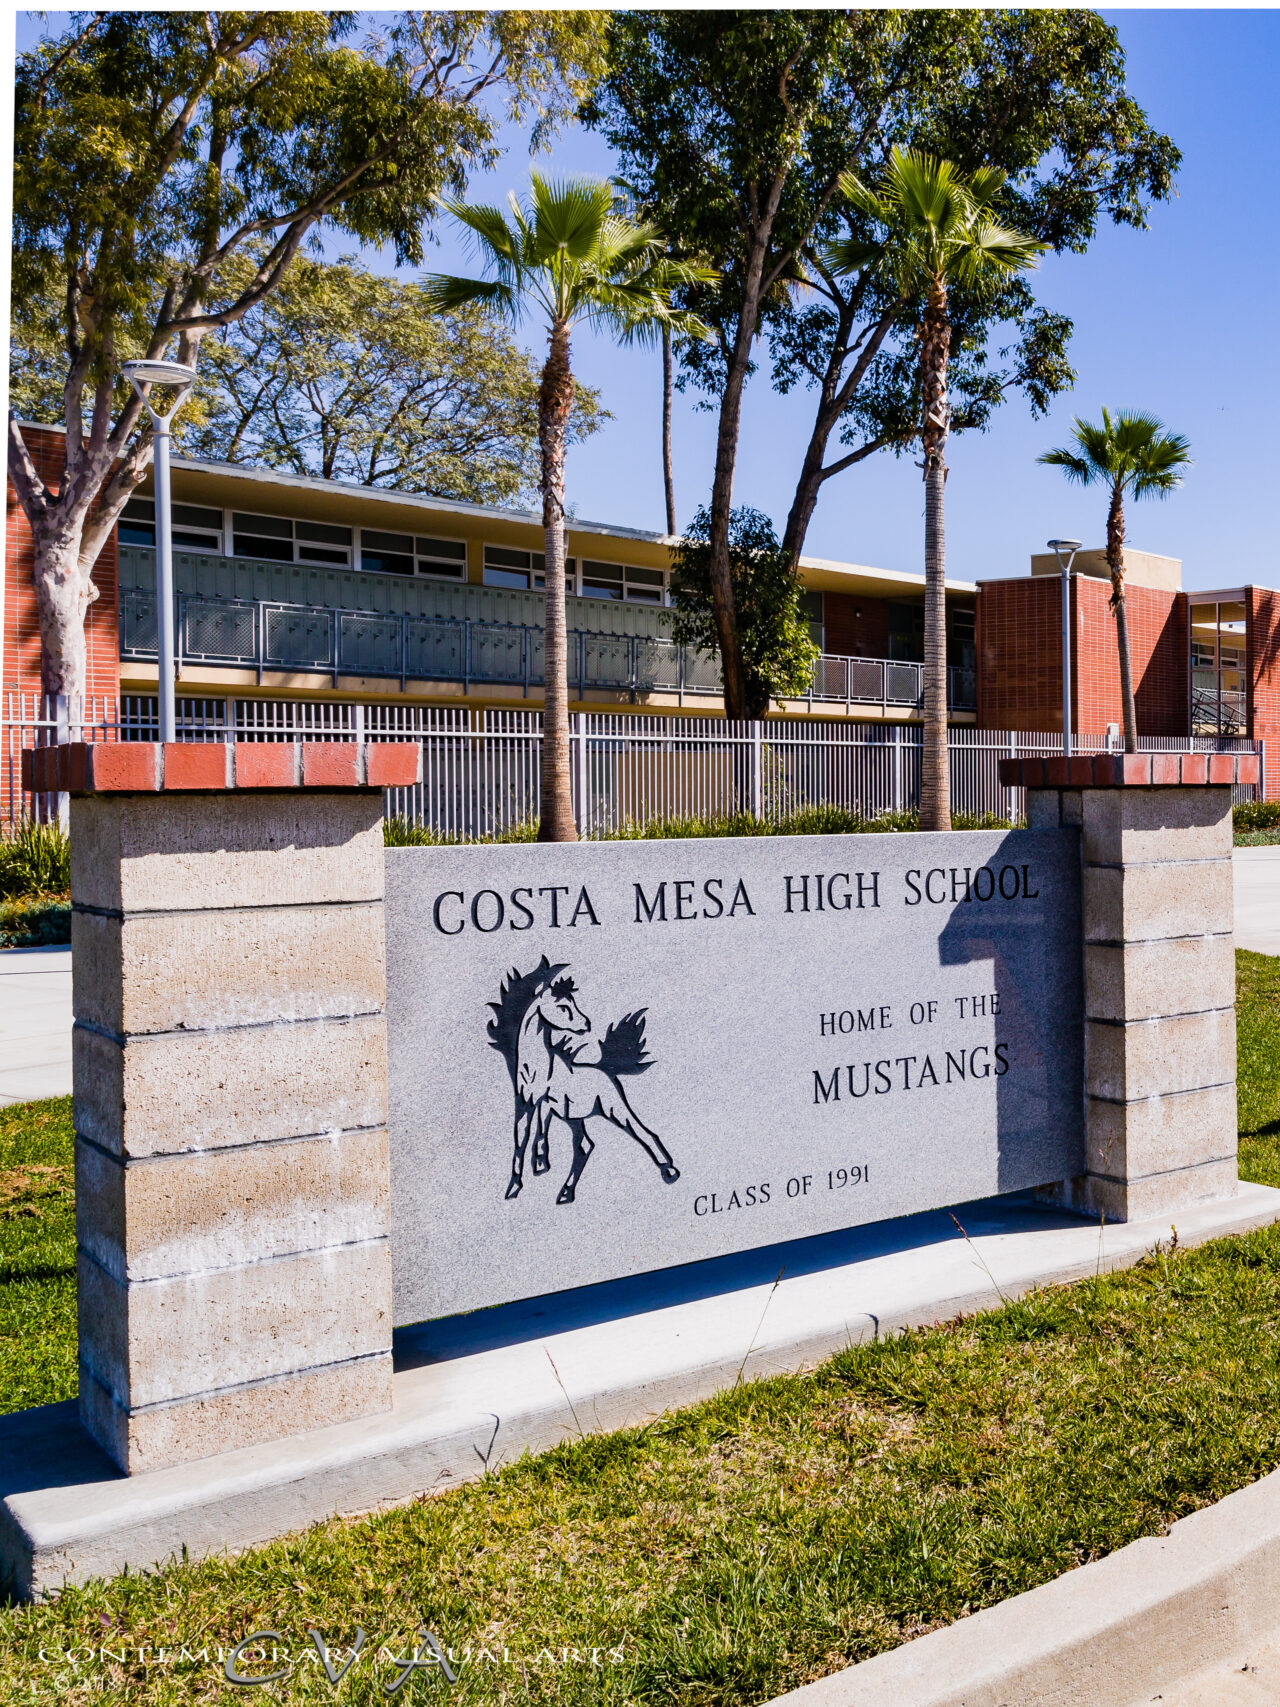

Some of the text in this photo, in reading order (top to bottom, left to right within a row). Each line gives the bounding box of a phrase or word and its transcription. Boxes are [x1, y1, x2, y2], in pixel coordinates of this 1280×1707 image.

[432, 864, 1039, 935] COSTA MESA HIGH SCHOOL
[819, 993, 1001, 1036] HOME OF THE
[812, 1043, 1009, 1104] MUSTANGS
[693, 1164, 870, 1217] CLASS OF 1991
